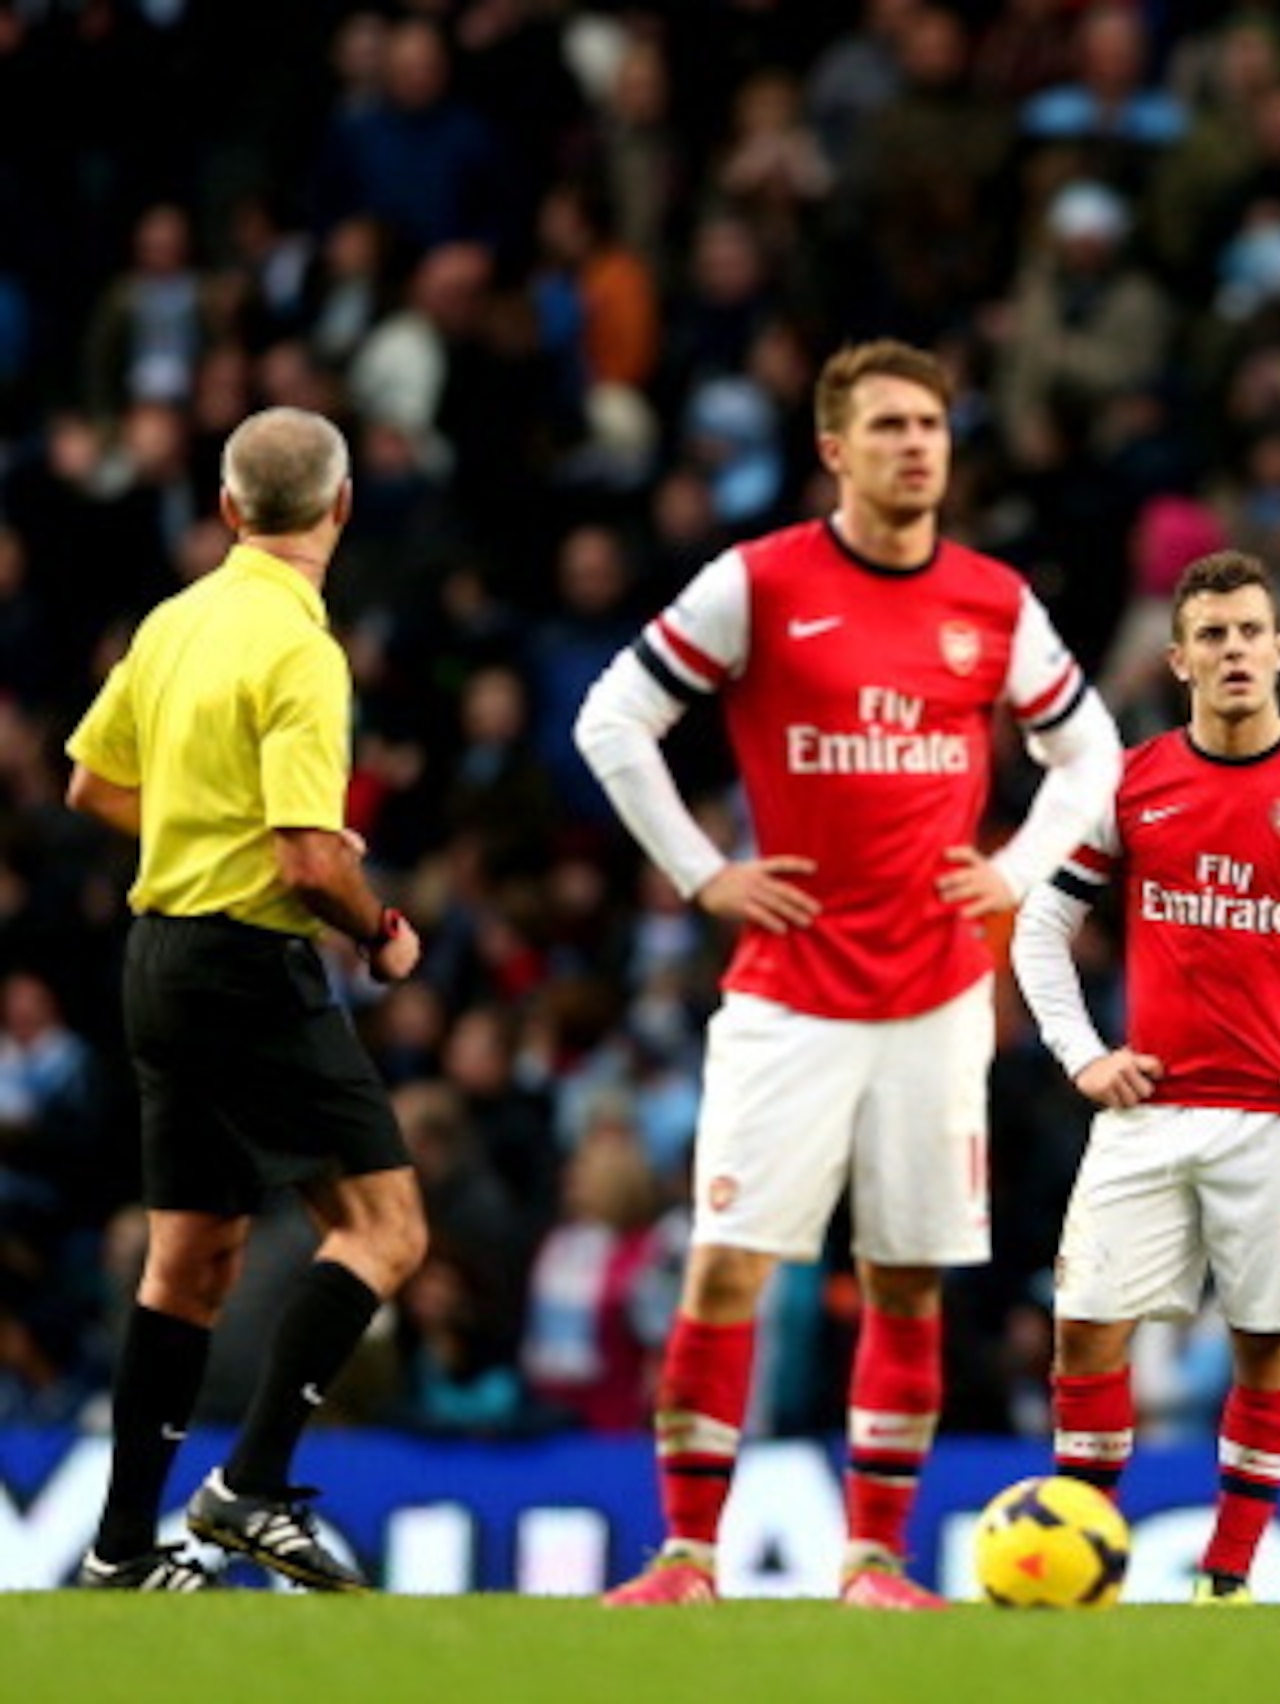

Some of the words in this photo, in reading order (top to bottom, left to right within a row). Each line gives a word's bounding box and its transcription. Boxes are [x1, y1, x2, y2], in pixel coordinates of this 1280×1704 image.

[859, 686, 924, 725] Fly
[786, 725, 970, 774] Emirates
[1197, 852, 1255, 892] Fly
